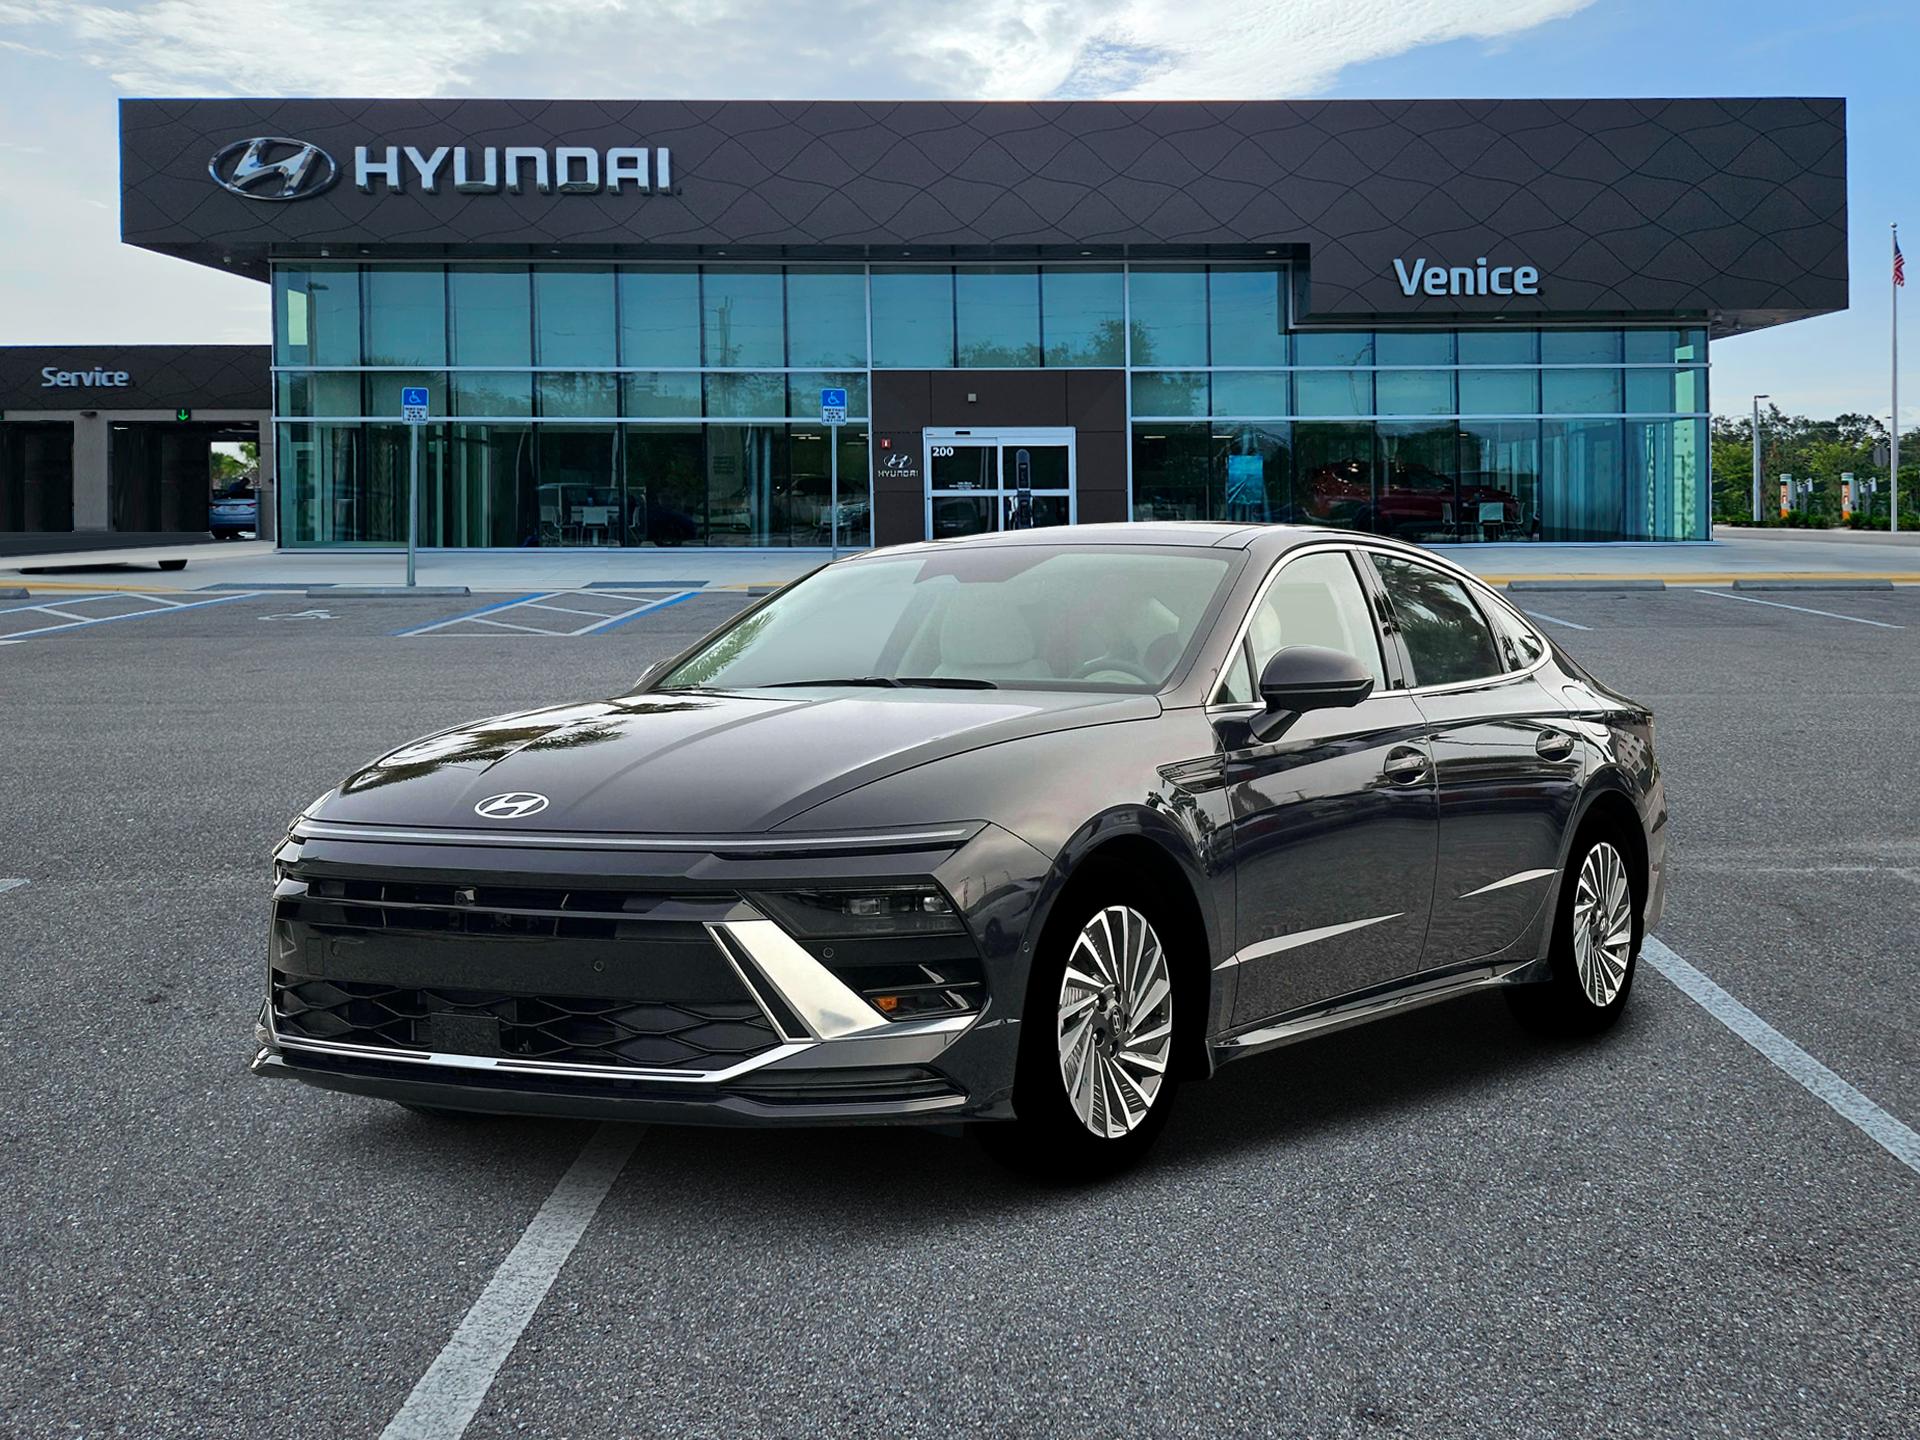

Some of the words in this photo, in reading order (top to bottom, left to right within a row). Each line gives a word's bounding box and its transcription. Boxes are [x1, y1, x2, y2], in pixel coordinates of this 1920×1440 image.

[354, 146, 674, 194] HYUNDAI
[1392, 257, 1540, 296] Venice
[41, 367, 129, 387] Service
[932, 447, 954, 457] 200
[878, 469, 919, 478] HYUNDAI
